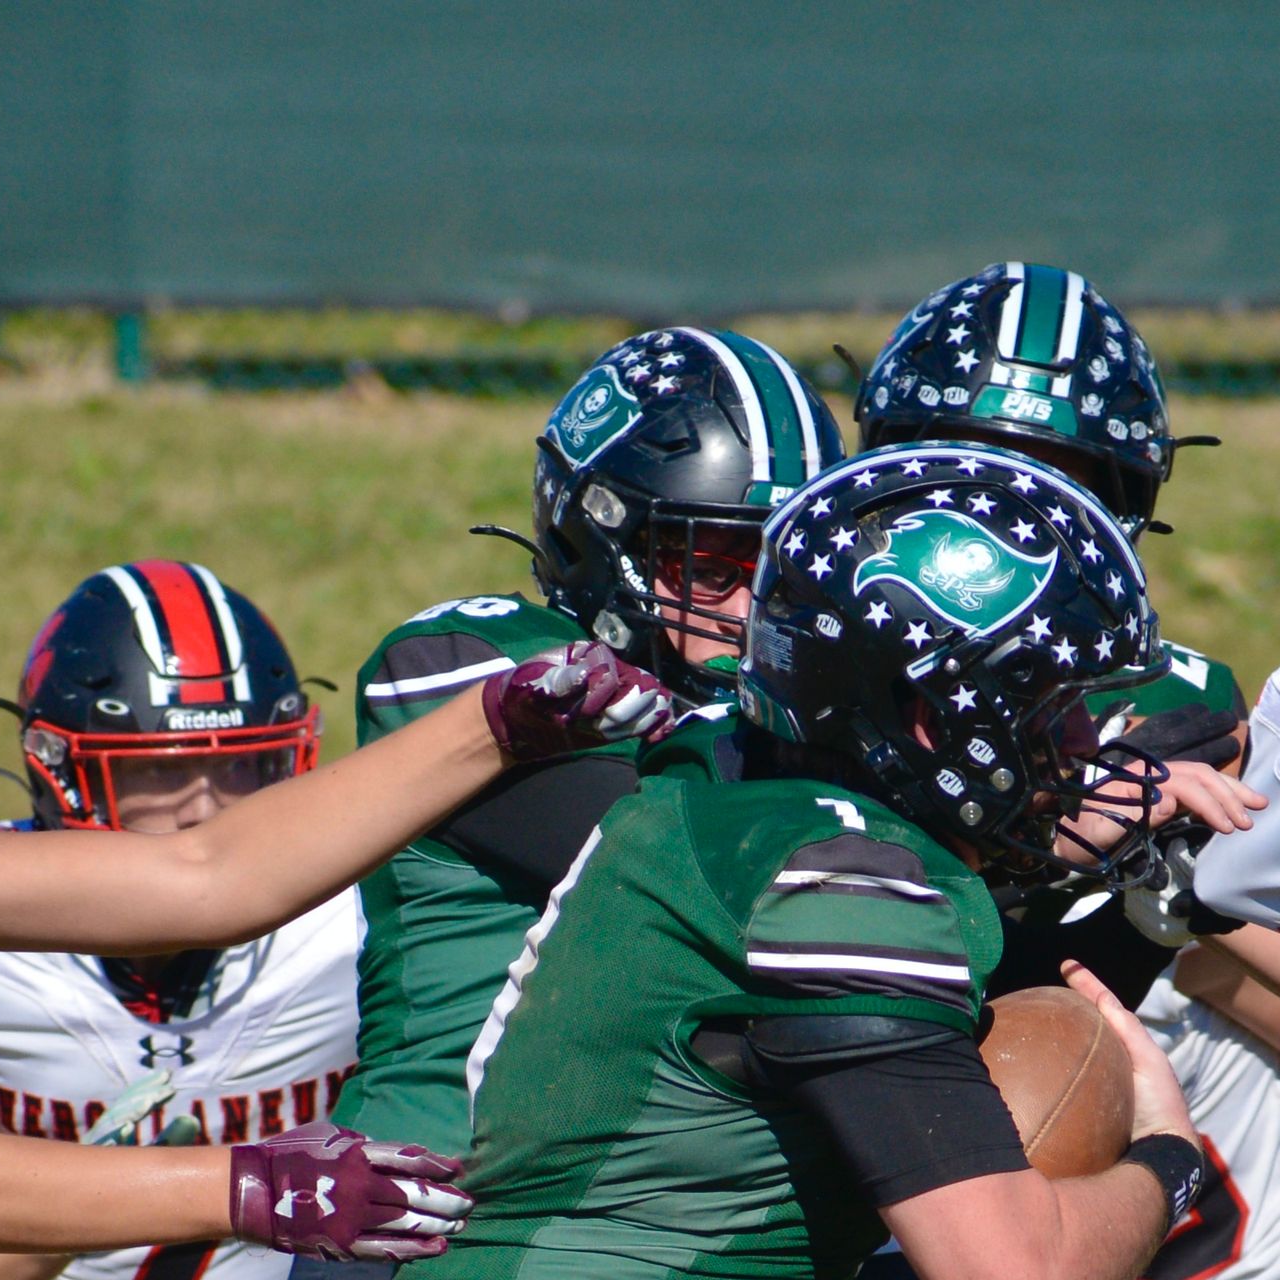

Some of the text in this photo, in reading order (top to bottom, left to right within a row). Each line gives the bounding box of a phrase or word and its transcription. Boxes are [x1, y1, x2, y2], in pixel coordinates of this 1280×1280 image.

[1001, 392, 1053, 420] PHS
[816, 613, 842, 638] TEAM
[168, 707, 244, 730] Riddell
[967, 737, 997, 765] TEAM
[936, 768, 965, 797] TEAM
